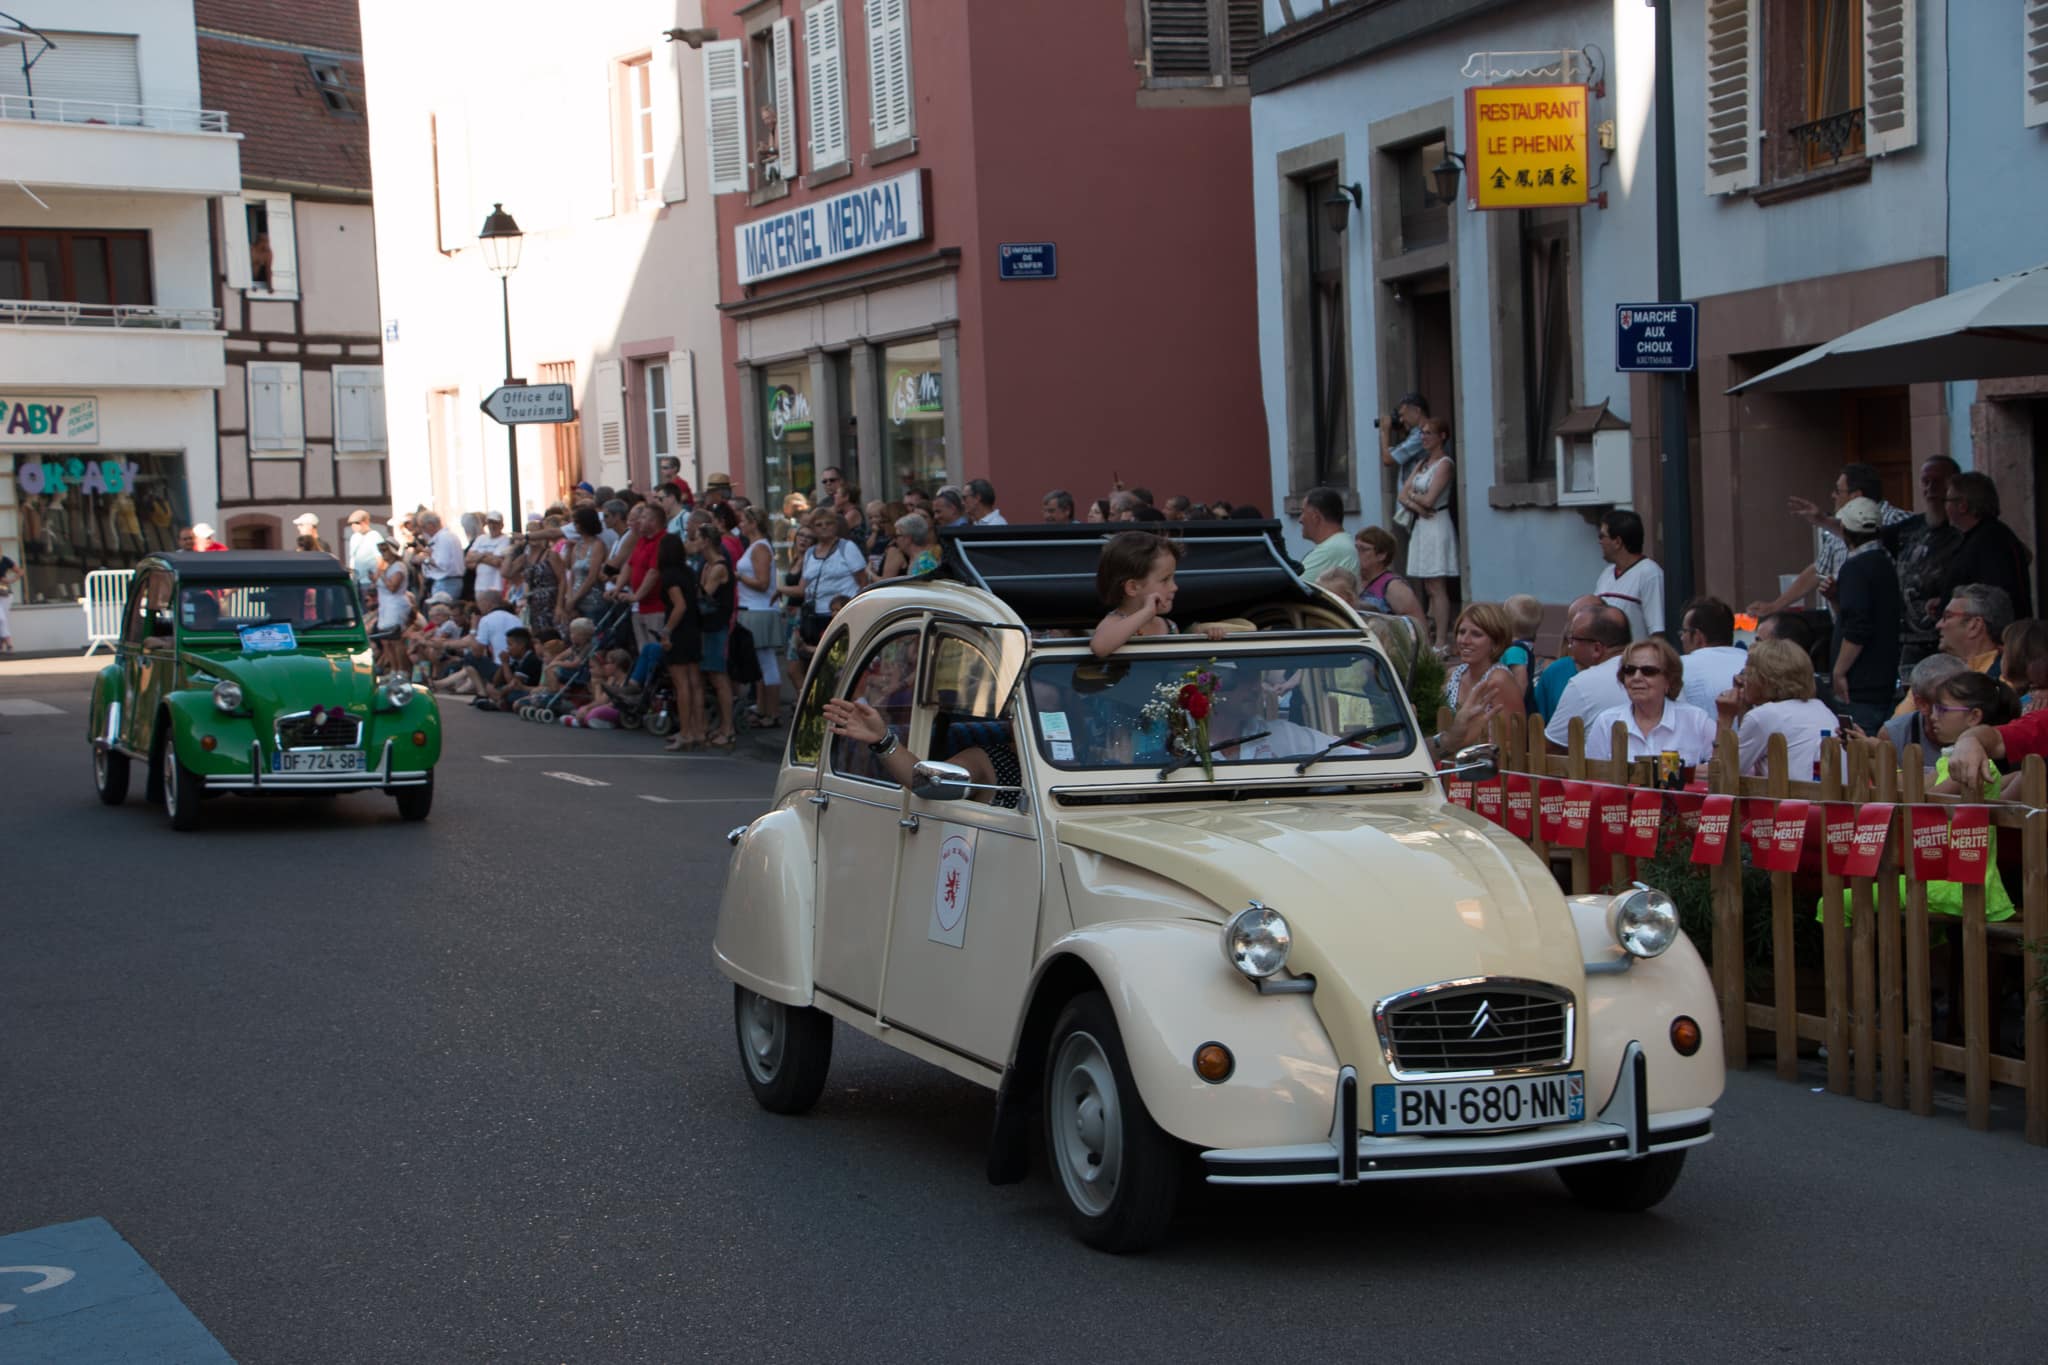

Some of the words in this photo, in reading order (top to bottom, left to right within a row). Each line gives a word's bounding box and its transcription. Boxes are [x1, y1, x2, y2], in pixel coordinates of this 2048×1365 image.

[1480, 101, 1579, 121] RESTAURANT
[1487, 137, 1507, 155] LE
[1512, 134, 1575, 153] PHENIX
[745, 207, 822, 277] MATERIEL
[827, 182, 907, 254] MEDICAL
[1634, 309, 1677, 322] MARCHÉ
[1645, 326, 1665, 337] AUX
[1637, 341, 1672, 352] CHOUX
[503, 392, 542, 403] Office
[548, 390, 564, 401] du
[505, 405, 564, 417] Tourisme
[1381, 1114, 1388, 1124] F
[1400, 1079, 1565, 1127] BN-680-NN
[1569, 1098, 1583, 1116] 67
